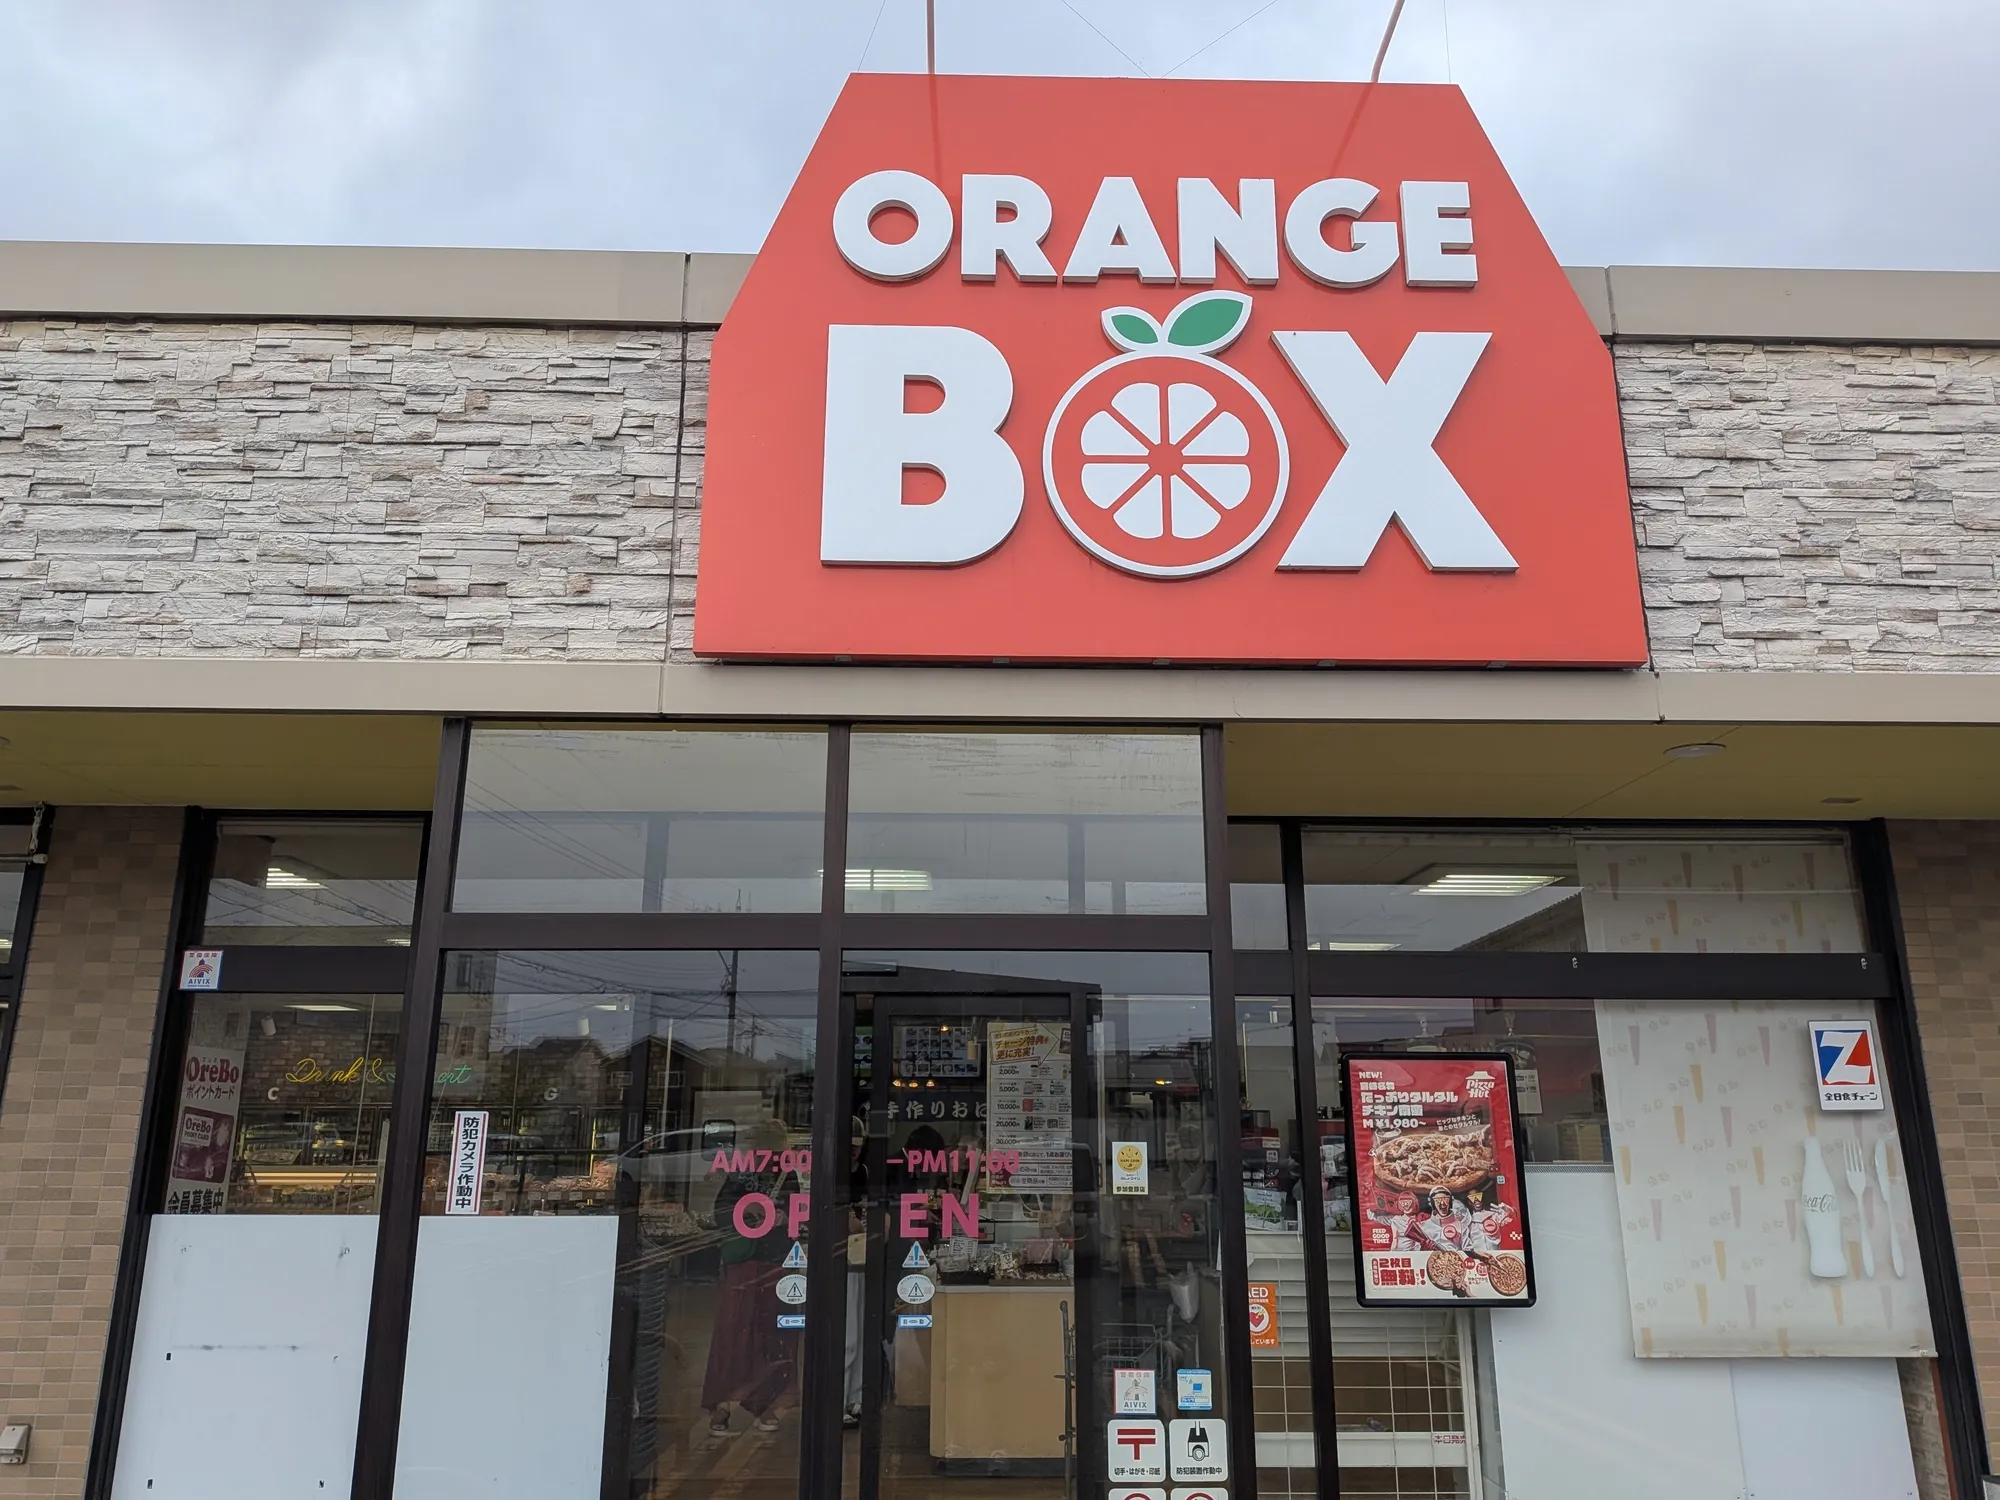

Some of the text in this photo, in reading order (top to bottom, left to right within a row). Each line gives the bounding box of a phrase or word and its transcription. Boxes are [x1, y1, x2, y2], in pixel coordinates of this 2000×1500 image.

[832, 170, 1478, 288] ORANGE
[820, 322, 1520, 579] BOX
[186, 1056, 240, 1084] OreBo
[1358, 1071, 1383, 1079] NEW!
[186, 1084, 236, 1100] ポイントカード
[1465, 1079, 1495, 1092] Pizza
[543, 1087, 559, 1101] G
[1360, 1091, 1459, 1104] たっぷりタルタル
[1468, 1087, 1490, 1099] Hut
[1824, 1091, 1878, 1102] 全日食チェーン
[185, 1117, 211, 1134] OreBo
[1362, 1118, 1374, 1129] M
[454, 1116, 480, 1209] 防犯カメラ作動中
[709, 1149, 811, 1173] AM7:00
[168, 1188, 224, 1214] 会員募集中
[1114, 1467, 1161, 1476] 切手・はがき・印紙
[1176, 1466, 1223, 1475] 防犯装置作動中
